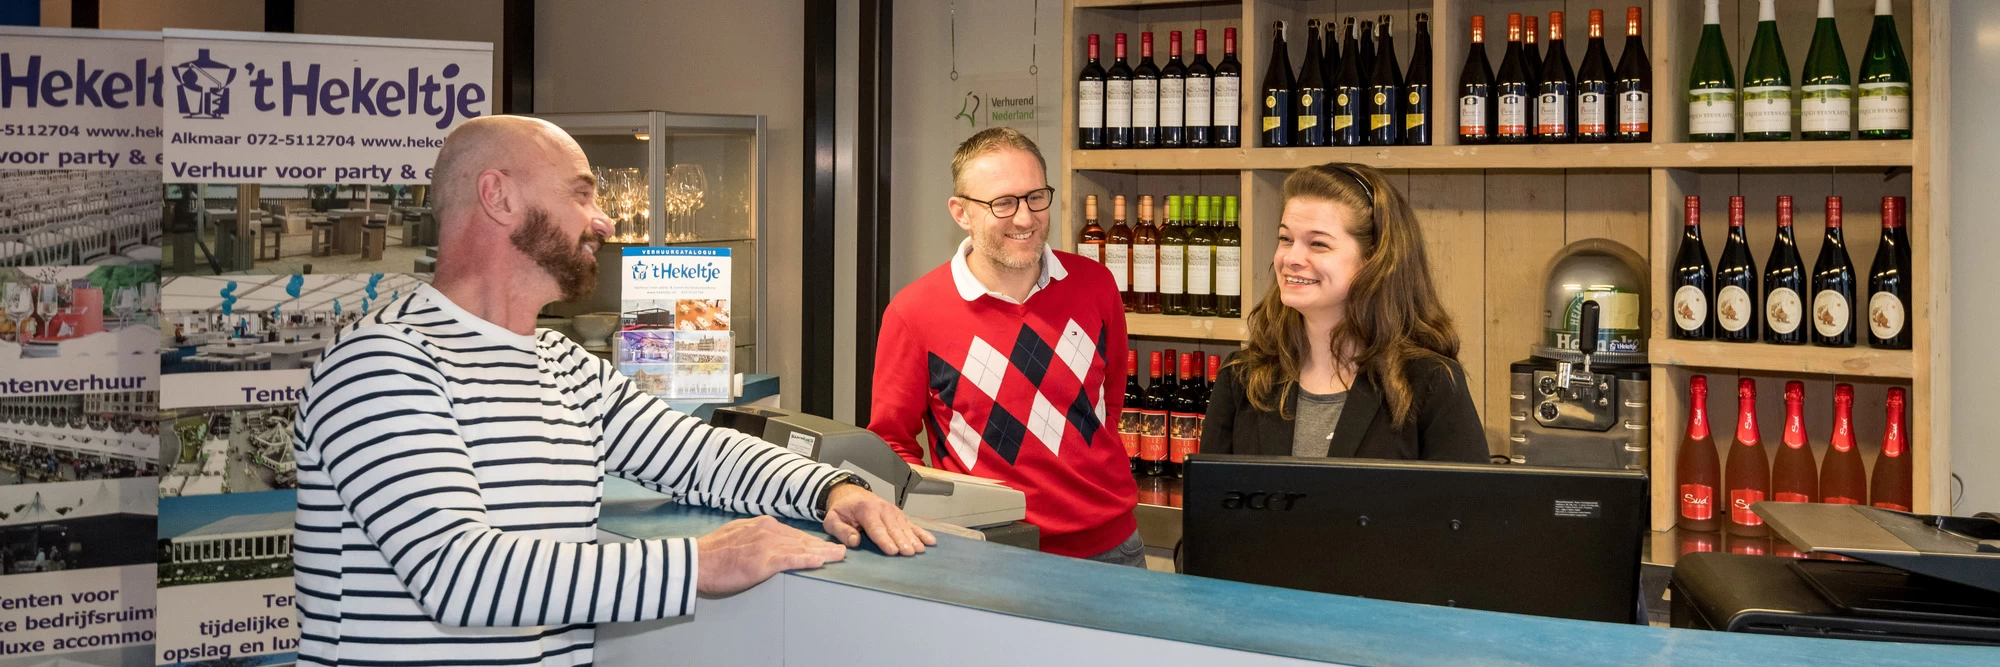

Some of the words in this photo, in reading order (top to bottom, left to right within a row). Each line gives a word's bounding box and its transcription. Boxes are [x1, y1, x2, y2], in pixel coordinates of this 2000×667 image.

[1, 52, 163, 109] Hekelt
[282, 61, 485, 129] Hekeltje
[991, 95, 1034, 107] Verhurend
[992, 109, 1034, 121] Nederland
[171, 132, 241, 145] Alkmaar
[247, 134, 355, 146] 072-5112704
[59, 149, 120, 168] party
[129, 149, 147, 165] &
[171, 162, 267, 179] Verhuur
[275, 165, 326, 179] voor
[335, 165, 392, 183] party
[400, 164, 417, 180] &
[661, 262, 721, 282] Hekeltje
[1221, 490, 1307, 511] acer
[1683, 494, 1709, 504] Sud
[1734, 499, 1750, 509] Su
[0, 593, 63, 610] enten
[71, 590, 119, 604] voor
[200, 615, 289, 638] tijdelijke
[53, 629, 156, 650] accommo
[164, 643, 231, 664] opslag
[240, 641, 265, 654] en
